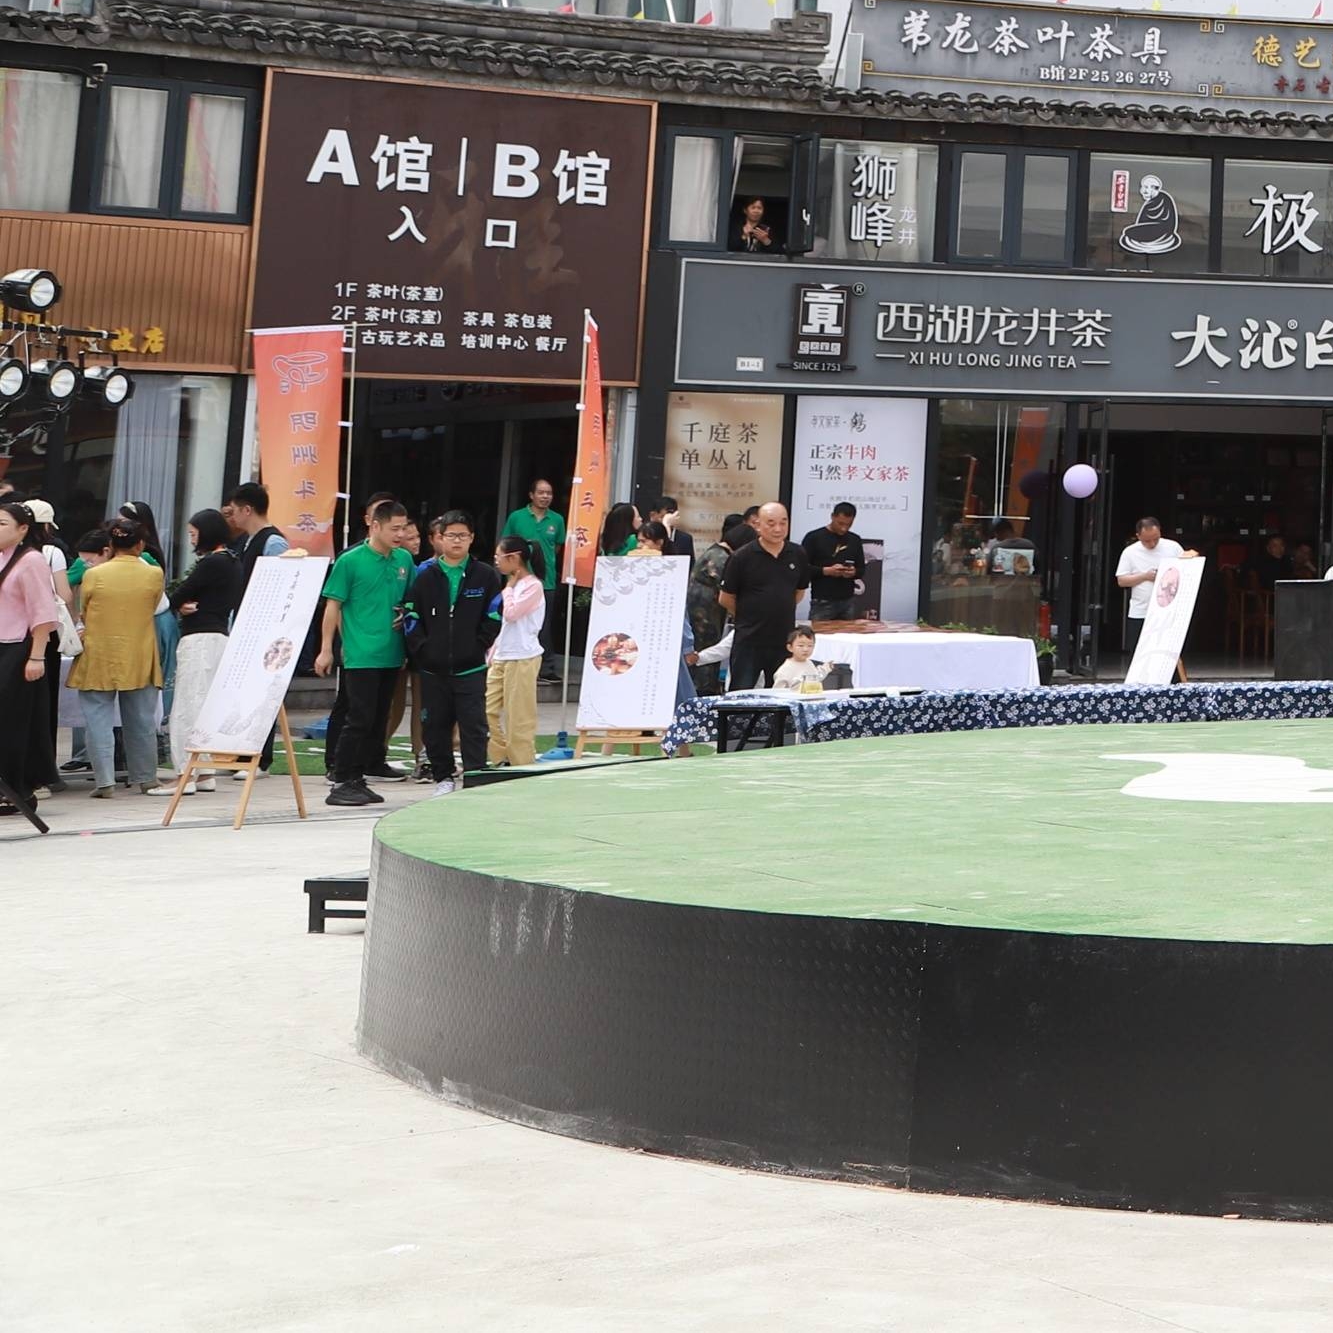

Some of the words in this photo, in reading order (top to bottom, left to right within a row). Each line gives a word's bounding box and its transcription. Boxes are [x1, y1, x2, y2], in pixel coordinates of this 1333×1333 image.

[1139, 70, 1172, 87] 27号
[306, 128, 431, 193] A馆
[492, 143, 610, 208] B馆
[851, 155, 898, 247] 狮峰
[388, 205, 516, 250] 入口
[898, 206, 917, 245] 龙井
[334, 283, 358, 297] 1F
[367, 283, 443, 302] 茶叶(茶室)
[331, 306, 356, 320] 2F
[364, 307, 442, 325] 茶叶(茶室)
[463, 311, 495, 327] 茶具
[504, 313, 552, 330] 茶包装
[876, 301, 1112, 348] 西湖龙井茶
[361, 329, 445, 348] 古玩艺术品
[461, 334, 528, 350] 培训中心
[793, 361, 818, 371] SINCE
[910, 351, 924, 364] XI
[930, 352, 952, 365] HU
[958, 353, 999, 367] LONG
[1005, 354, 1042, 368] JING
[1048, 355, 1076, 369] TEA
[681, 422, 759, 443] 千庭茶
[680, 449, 757, 471] 单丛礼
[810, 444, 876, 460] 正宗牛肉
[808, 464, 910, 481] 当然孝文家茶
